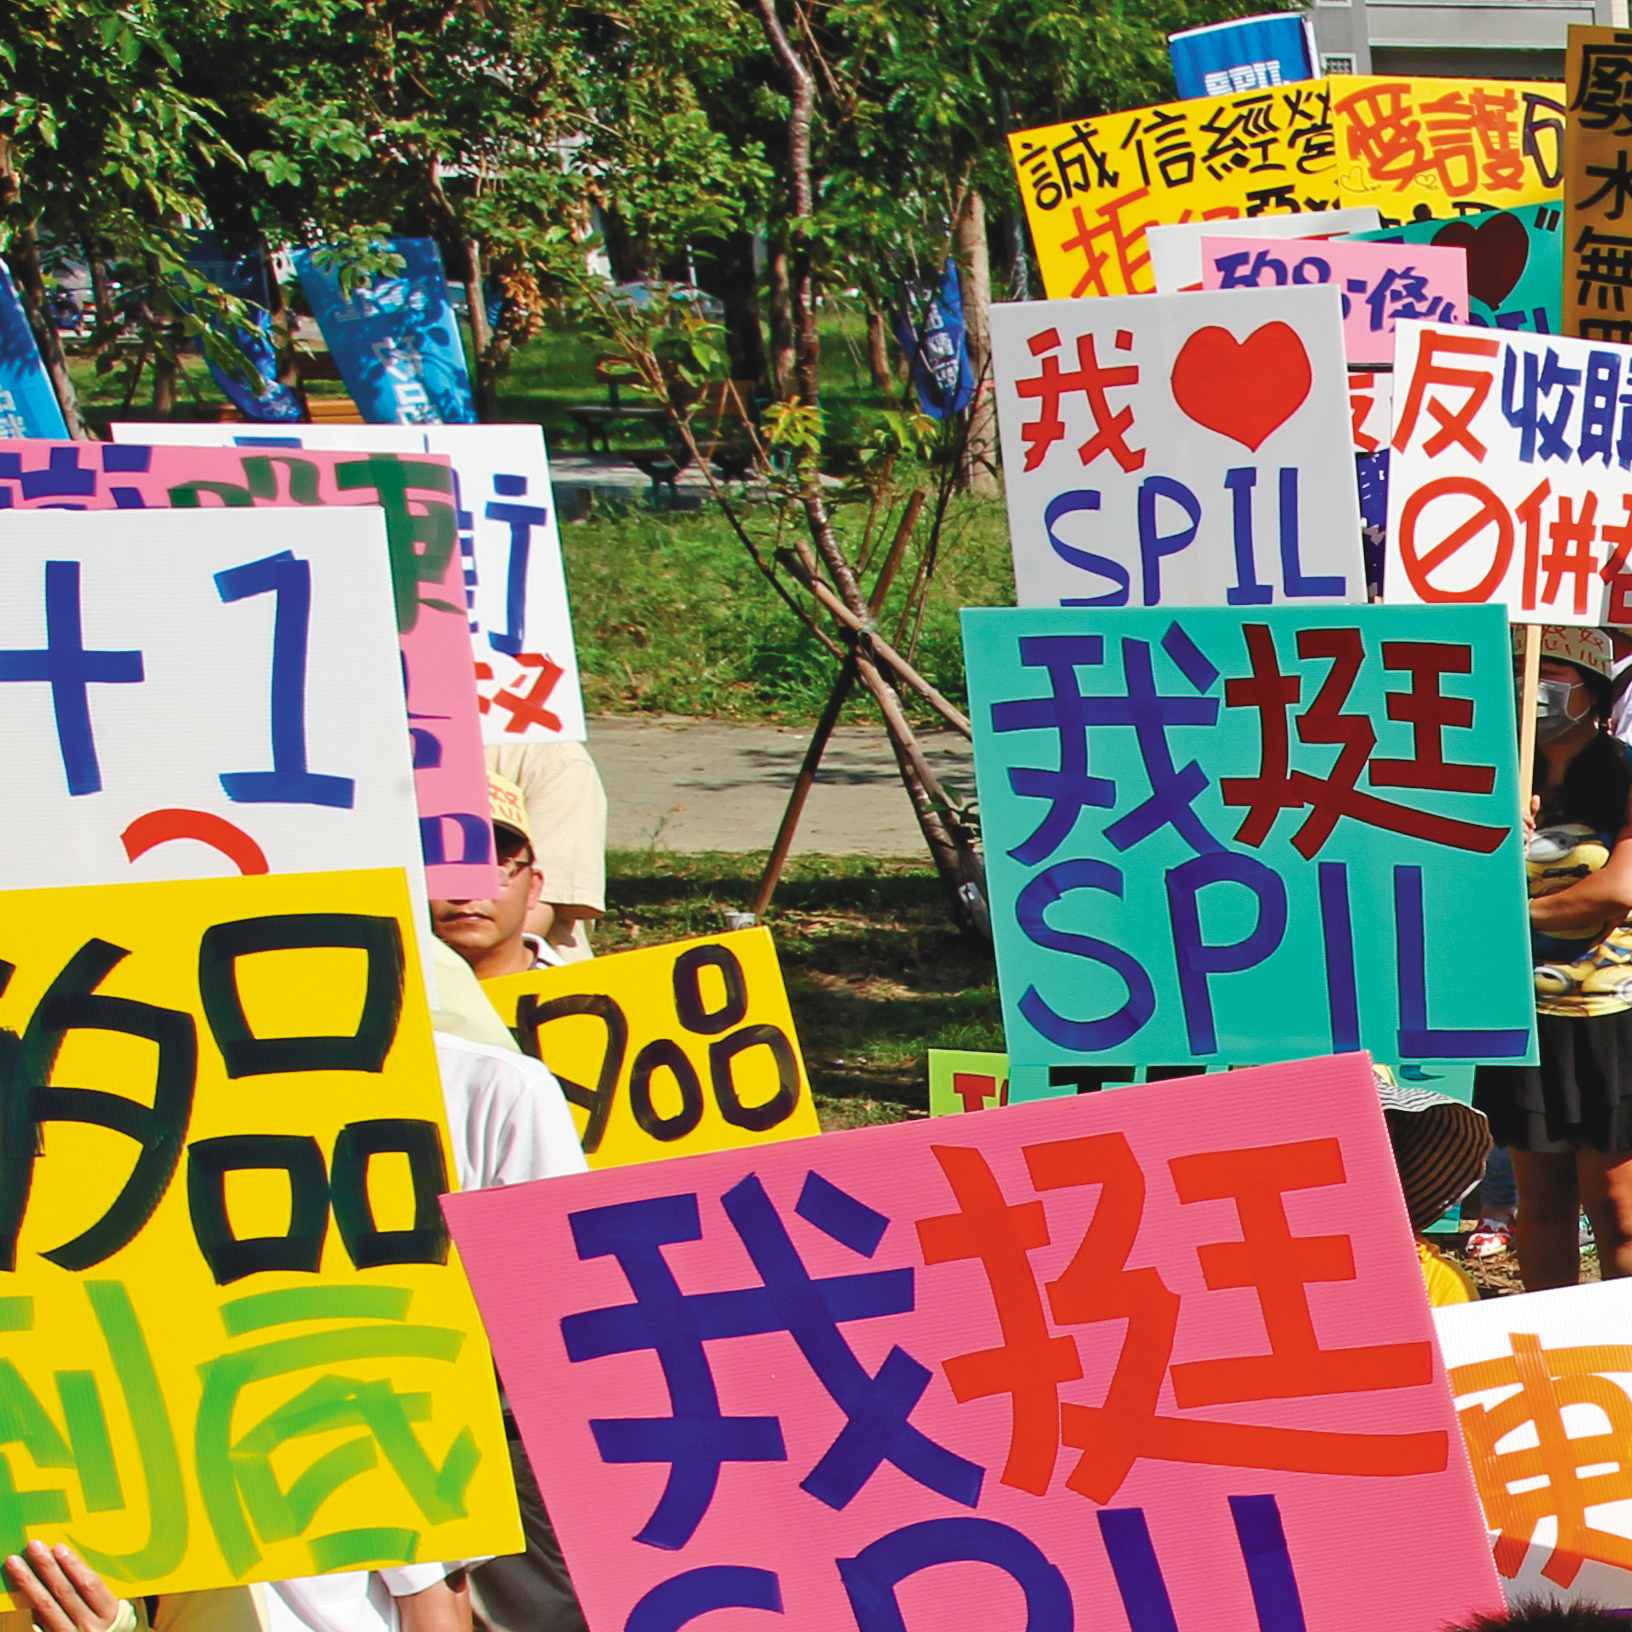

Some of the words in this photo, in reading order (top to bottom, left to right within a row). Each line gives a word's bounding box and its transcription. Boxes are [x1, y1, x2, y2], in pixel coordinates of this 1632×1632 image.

[1015, 320, 1149, 473] 我
[1043, 466, 1346, 606] SPIL
[989, 619, 1512, 864] 我挺
[1014, 850, 1531, 1059] SPIL
[557, 1131, 1449, 1552] 我挺
